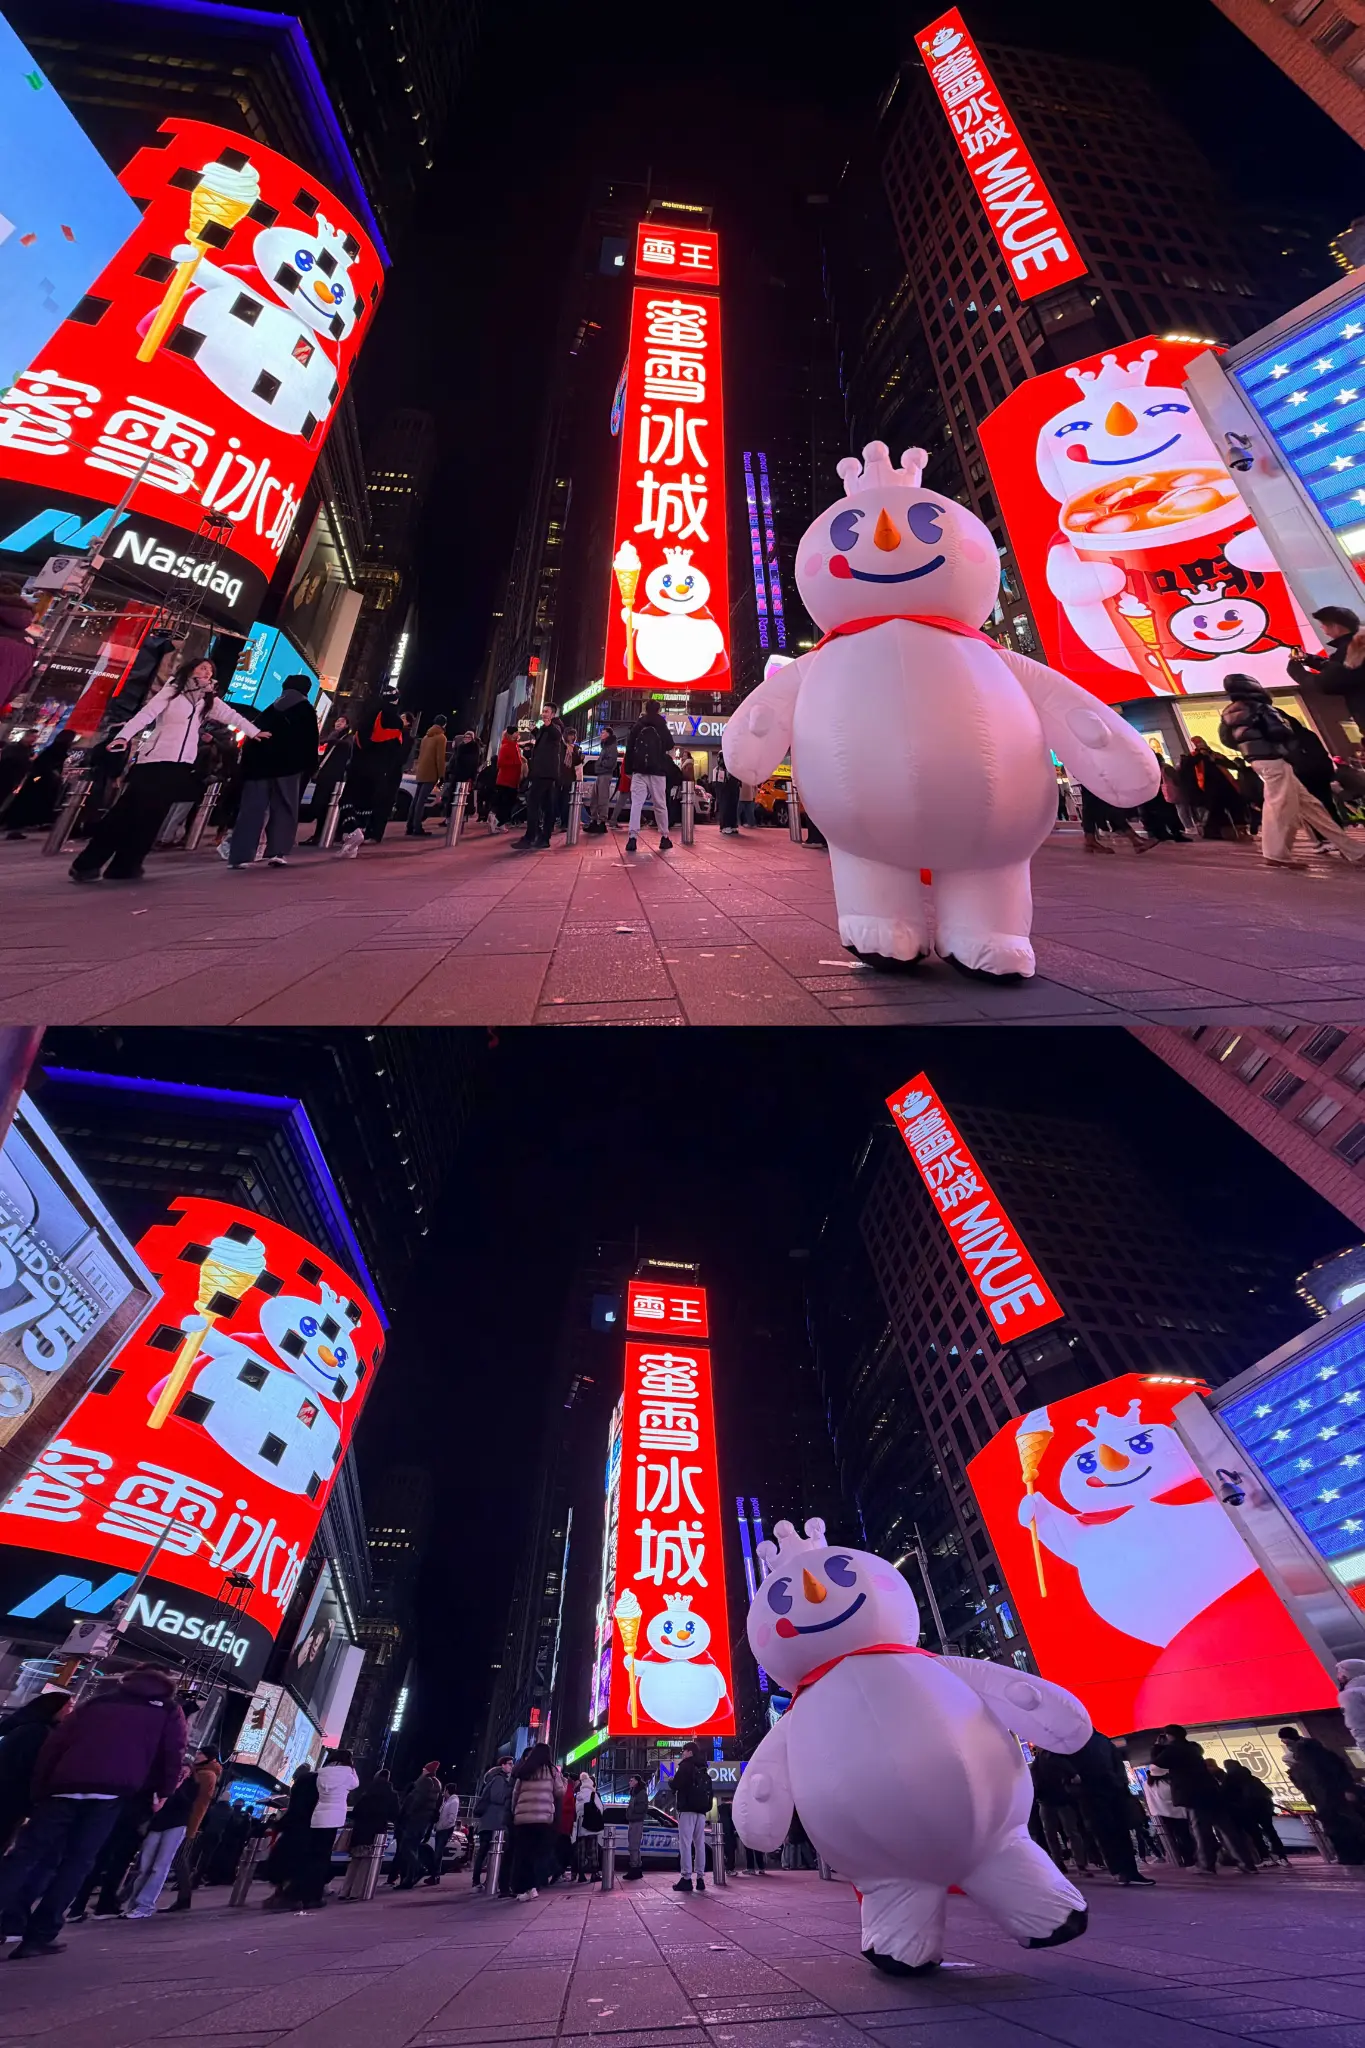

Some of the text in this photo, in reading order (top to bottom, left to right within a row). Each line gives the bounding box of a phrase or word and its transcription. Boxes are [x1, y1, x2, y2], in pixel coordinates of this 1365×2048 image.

[931, 46, 1070, 281] 蜜雪冰城 MIXUE
[642, 237, 713, 270] 雪王
[634, 299, 710, 543] 蜜雪冰城
[113, 530, 243, 607] Nasdaq
[50, 663, 83, 673] REWRITE
[903, 1107, 1046, 1325] 蜜雪冰城 MIXUE
[40, 1239, 104, 1315] DOCUMENTARY
[633, 1294, 702, 1323] 雪王
[633, 1353, 709, 1588] 蜜雪冰城
[123, 1593, 250, 1667] Nasdaq
